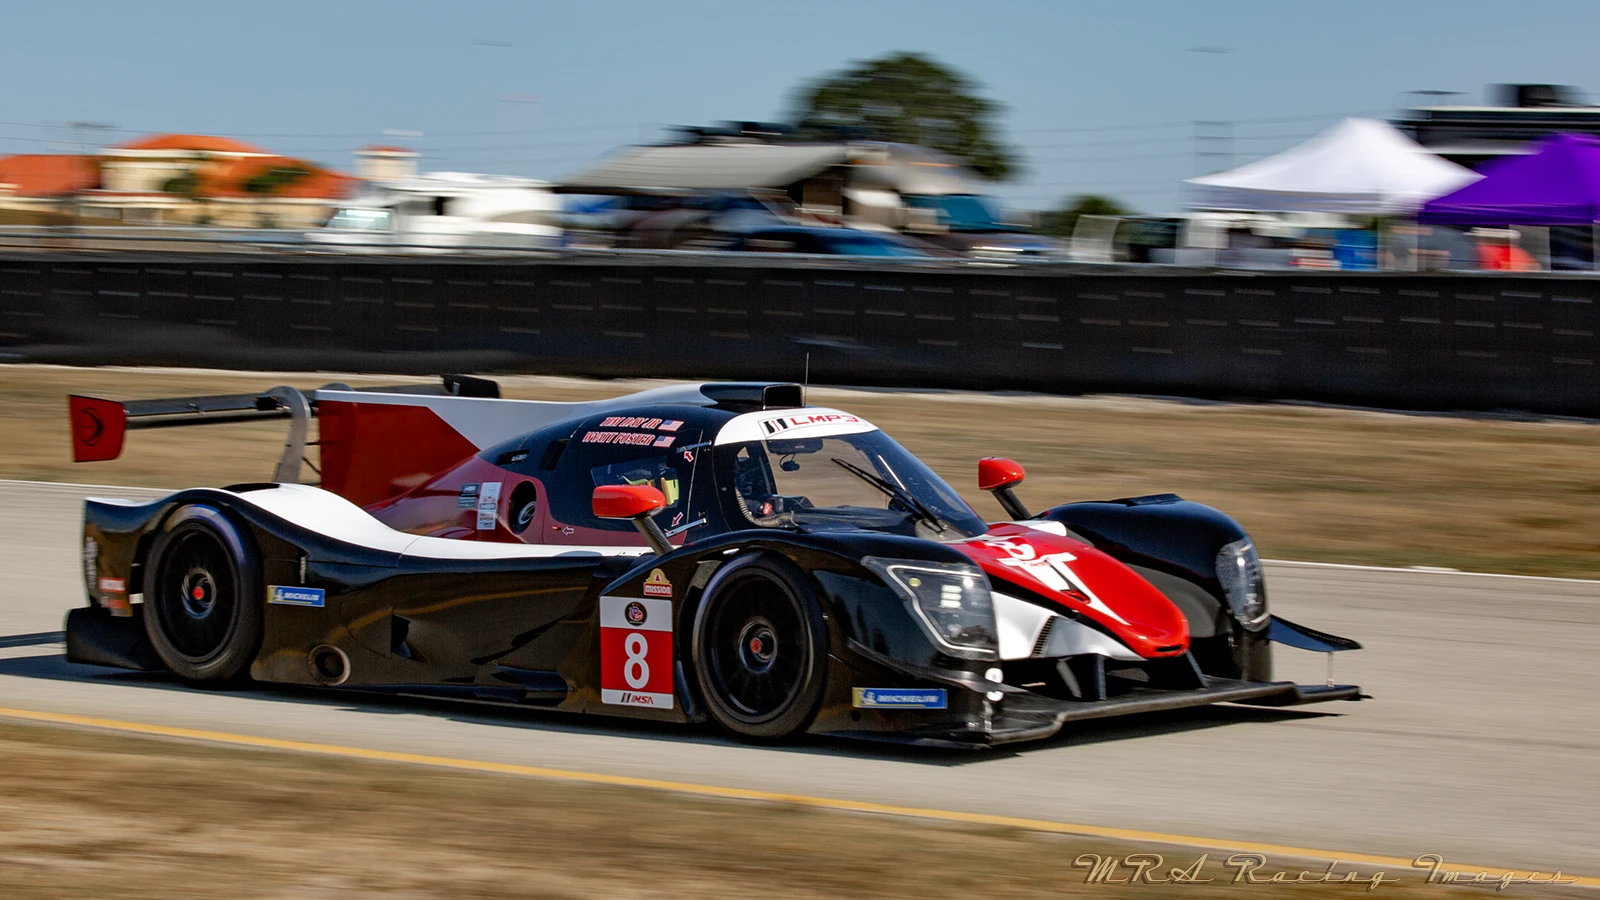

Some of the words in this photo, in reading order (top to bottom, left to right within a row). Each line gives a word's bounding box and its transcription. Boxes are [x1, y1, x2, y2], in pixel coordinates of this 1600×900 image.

[790, 415, 860, 426] LMP3
[582, 431, 619, 443] WYATT
[612, 433, 656, 446] FOSTER
[624, 632, 650, 689] 8
[631, 694, 654, 705] IMSA
[876, 694, 939, 703] MICHELIN
